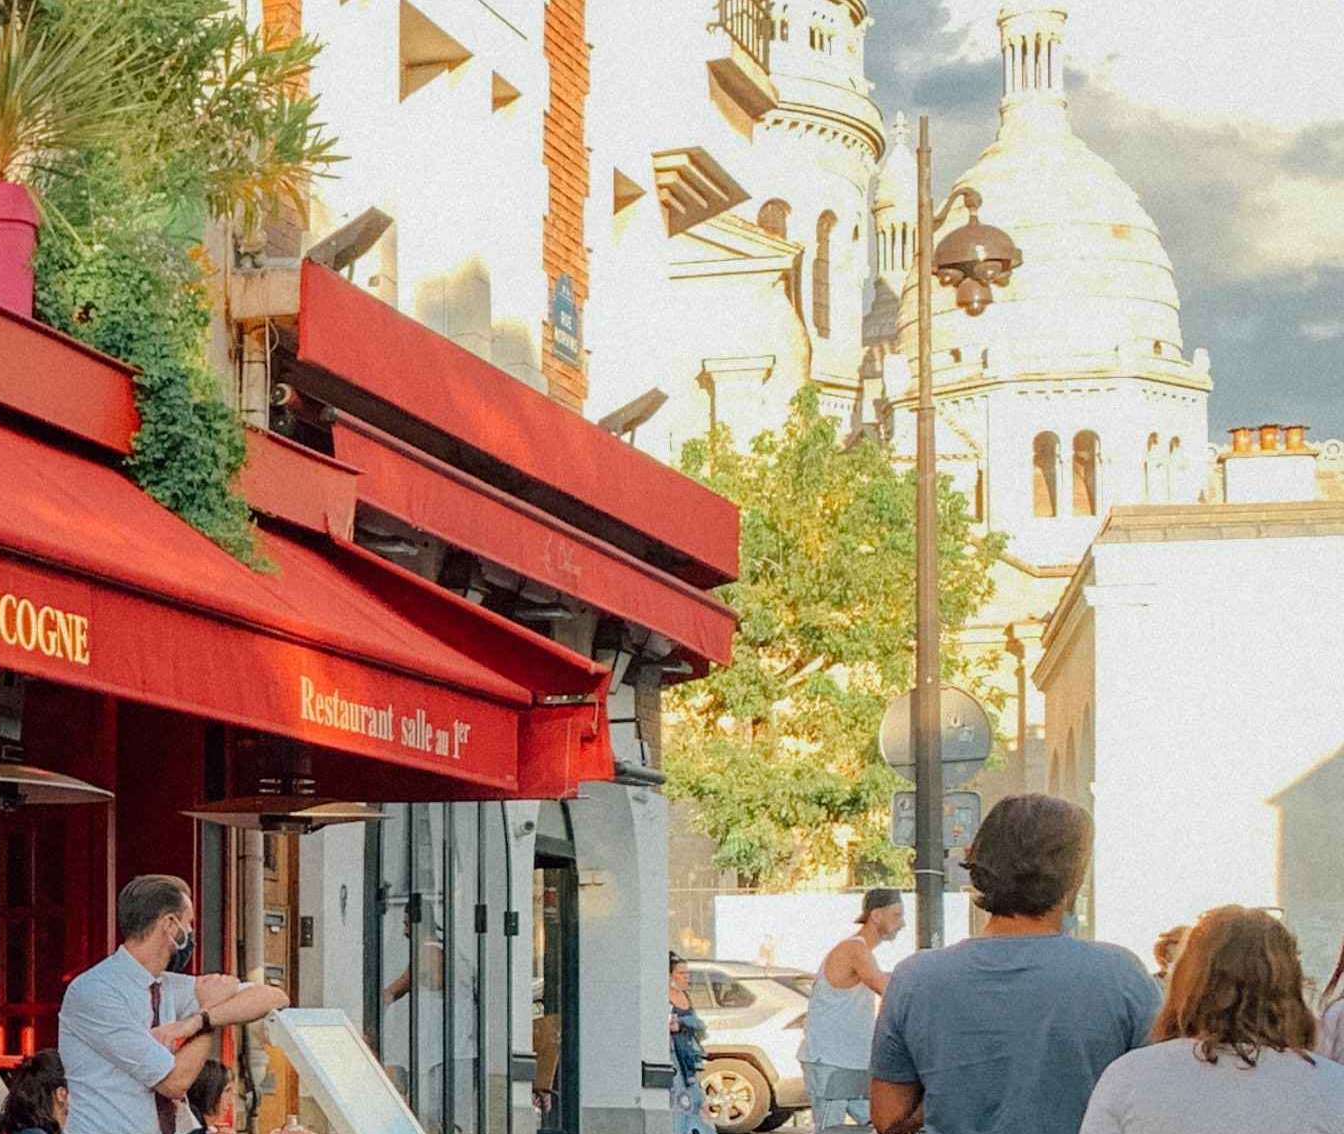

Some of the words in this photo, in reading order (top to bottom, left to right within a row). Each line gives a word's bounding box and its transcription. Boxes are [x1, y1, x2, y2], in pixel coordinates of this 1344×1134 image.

[299, 674, 395, 742] Restaurant
[400, 708, 433, 752] salle
[434, 729, 450, 757] au
